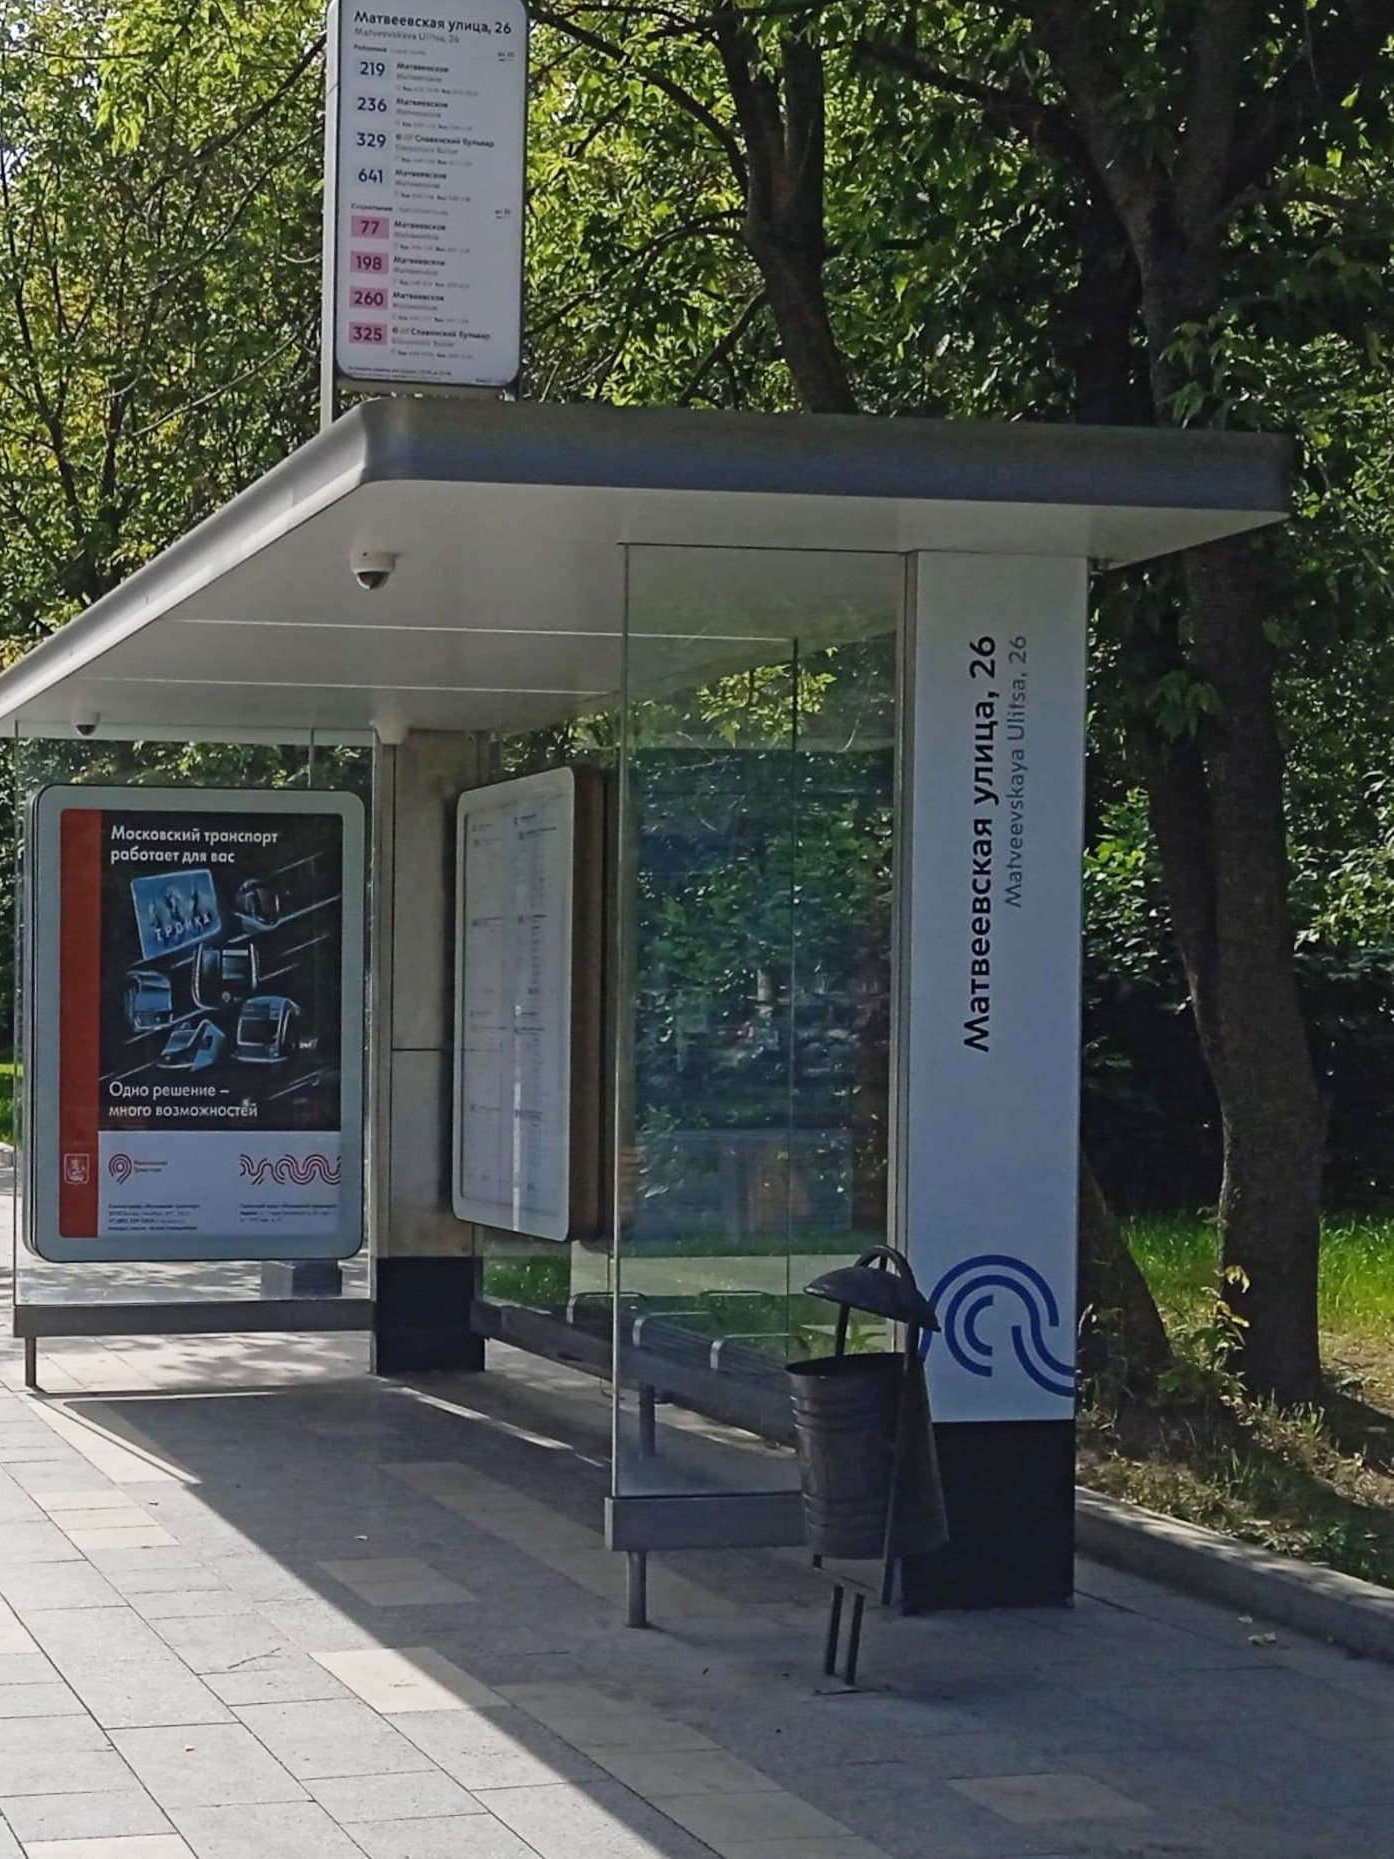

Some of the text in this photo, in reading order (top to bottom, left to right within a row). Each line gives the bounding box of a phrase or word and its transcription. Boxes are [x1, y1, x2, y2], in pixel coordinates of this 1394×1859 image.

[354, 10, 512, 36] Матвеевская улица, 26
[359, 61, 386, 77] 219
[357, 97, 387, 113] 236
[357, 132, 386, 148] 329
[358, 168, 383, 184] 641
[361, 219, 380, 235] 77
[356, 255, 382, 271] 198
[354, 291, 384, 306] 260
[353, 326, 383, 342] 325
[1005, 635, 1029, 908] Matveevskaya Ulitsa, 26
[110, 825, 279, 847] Московский транспорт
[964, 635, 1000, 1053] Матвеевская улица, 26
[110, 845, 236, 865] работает для вас
[109, 1081, 149, 1098] Одно
[153, 1085, 216, 1101] решение
[108, 1102, 258, 1117] много возможностей
